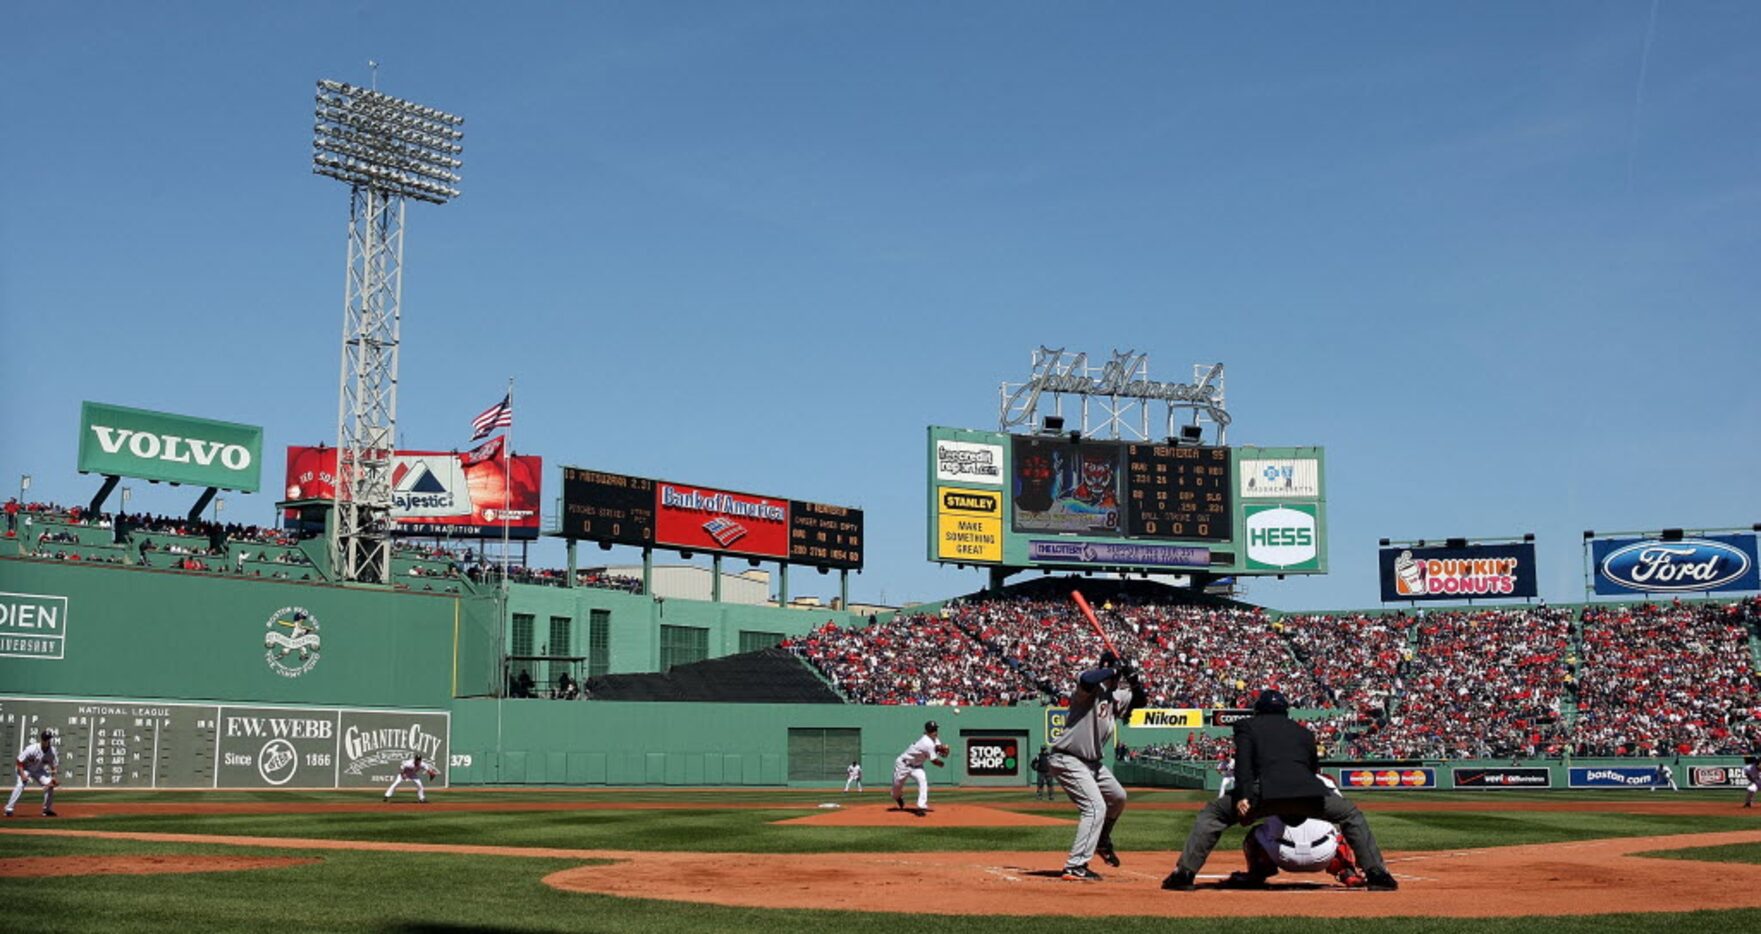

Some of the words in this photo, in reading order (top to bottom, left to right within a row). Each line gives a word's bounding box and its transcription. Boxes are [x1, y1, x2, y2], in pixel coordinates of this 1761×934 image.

[91, 424, 251, 470] VOLVO
[1153, 446, 1200, 458] RENTERIA
[391, 494, 446, 511] ajestic
[661, 486, 703, 509] Bank
[704, 493, 721, 511] of
[723, 495, 785, 520] America
[947, 495, 995, 510] STANLEY
[958, 520, 983, 532] MAKE
[945, 531, 995, 545] SOMETHING
[1251, 527, 1312, 547] HESS
[956, 543, 985, 555] GREAT
[1428, 559, 1517, 577] DUNKIN'
[1631, 547, 1720, 582] Ford
[1428, 576, 1514, 593] DONUTS
[79, 706, 128, 715] NATIONAL
[131, 708, 171, 717] LEAGUE
[1144, 711, 1188, 726] Nikon
[269, 718, 333, 739] WEBB
[224, 752, 252, 766] Since
[305, 753, 331, 766] 1866
[450, 754, 472, 767] 379
